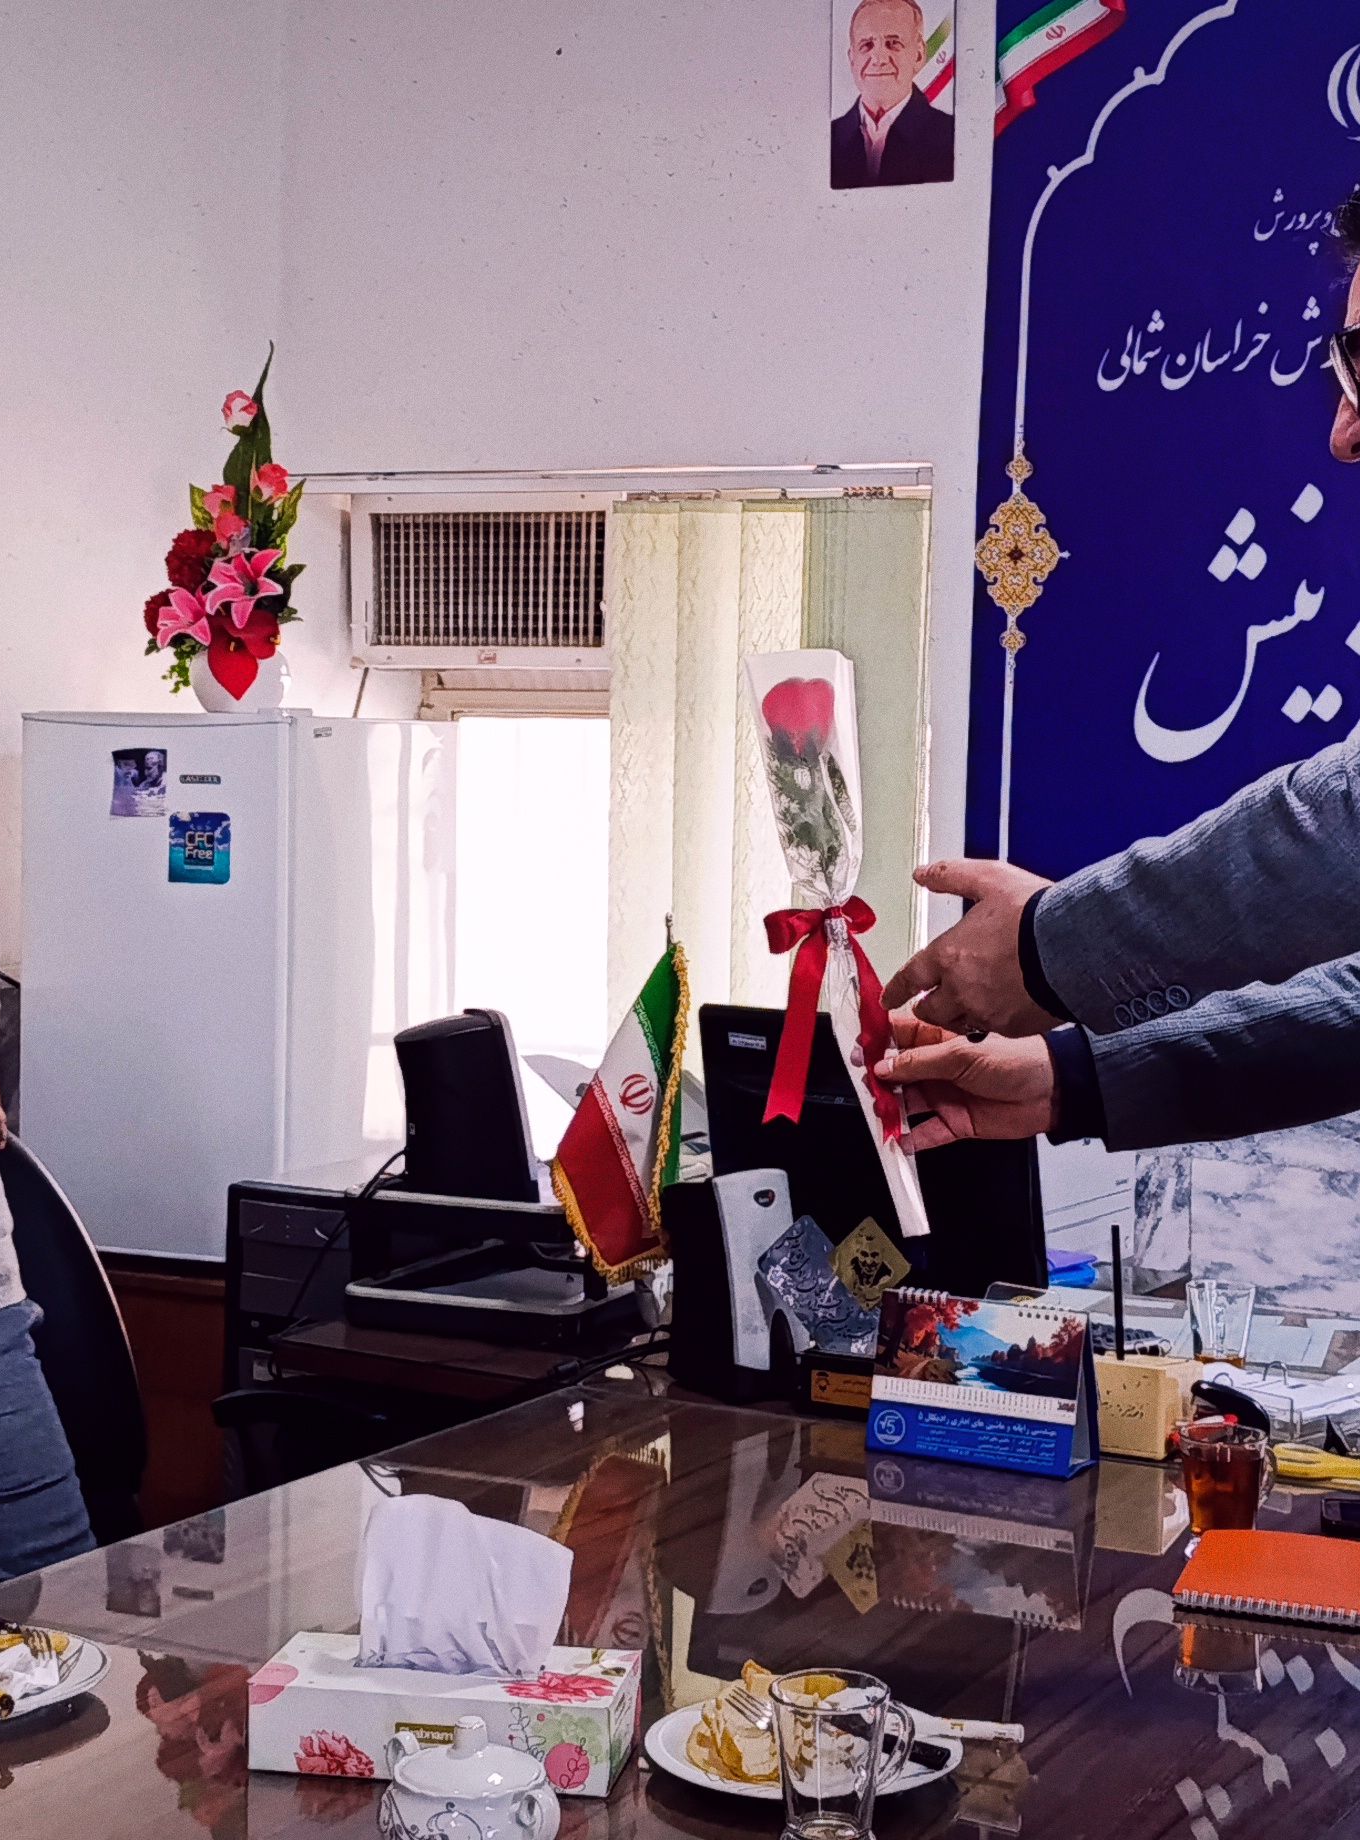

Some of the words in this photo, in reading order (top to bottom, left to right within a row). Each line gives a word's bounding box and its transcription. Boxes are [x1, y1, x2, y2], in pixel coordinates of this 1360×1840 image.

[1253, 187, 1322, 257] پرورش
[1096, 308, 1165, 392] شمالی
[1159, 301, 1272, 391] خراسان
[184, 831, 214, 847] CFC
[184, 846, 214, 860] Free
